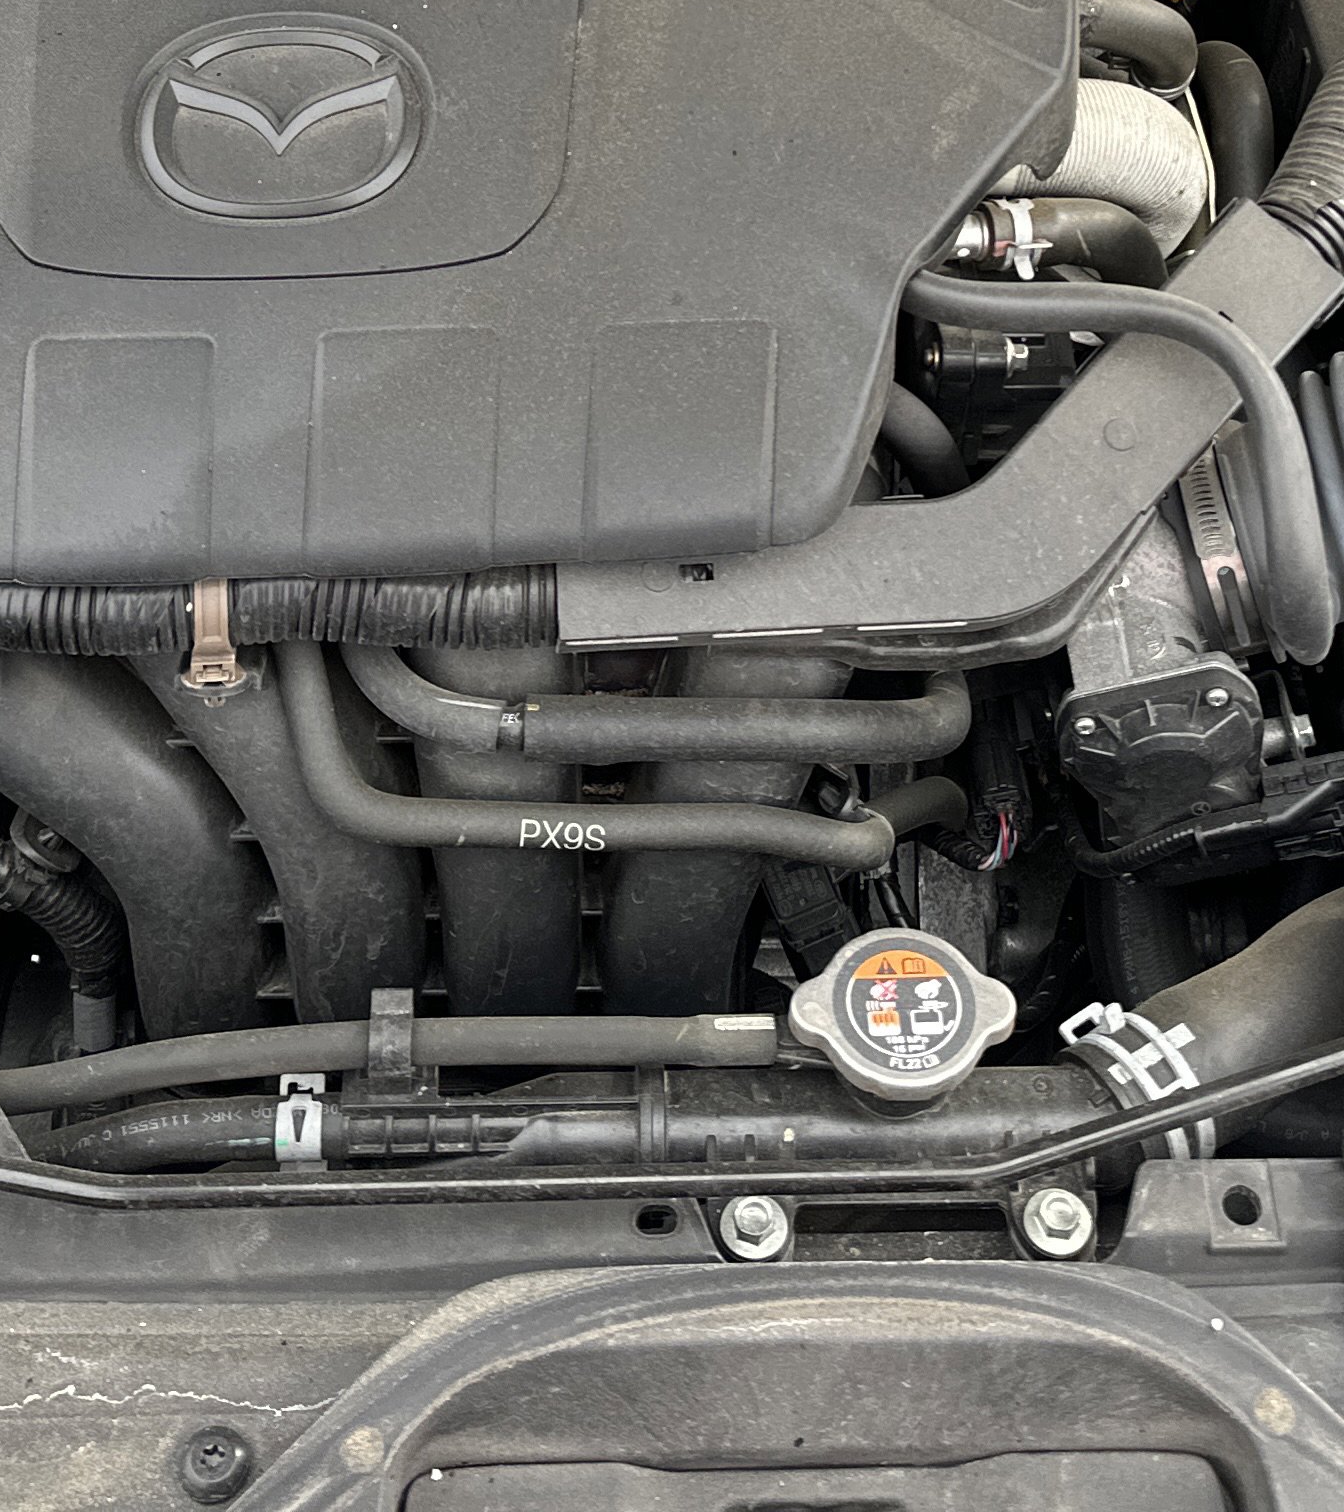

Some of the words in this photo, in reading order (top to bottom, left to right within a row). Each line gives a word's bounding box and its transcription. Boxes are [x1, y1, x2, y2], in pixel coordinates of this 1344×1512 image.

[519, 818, 607, 852] PX9S
[889, 1056, 923, 1069] FL22
[120, 1113, 190, 1137] 1115551
